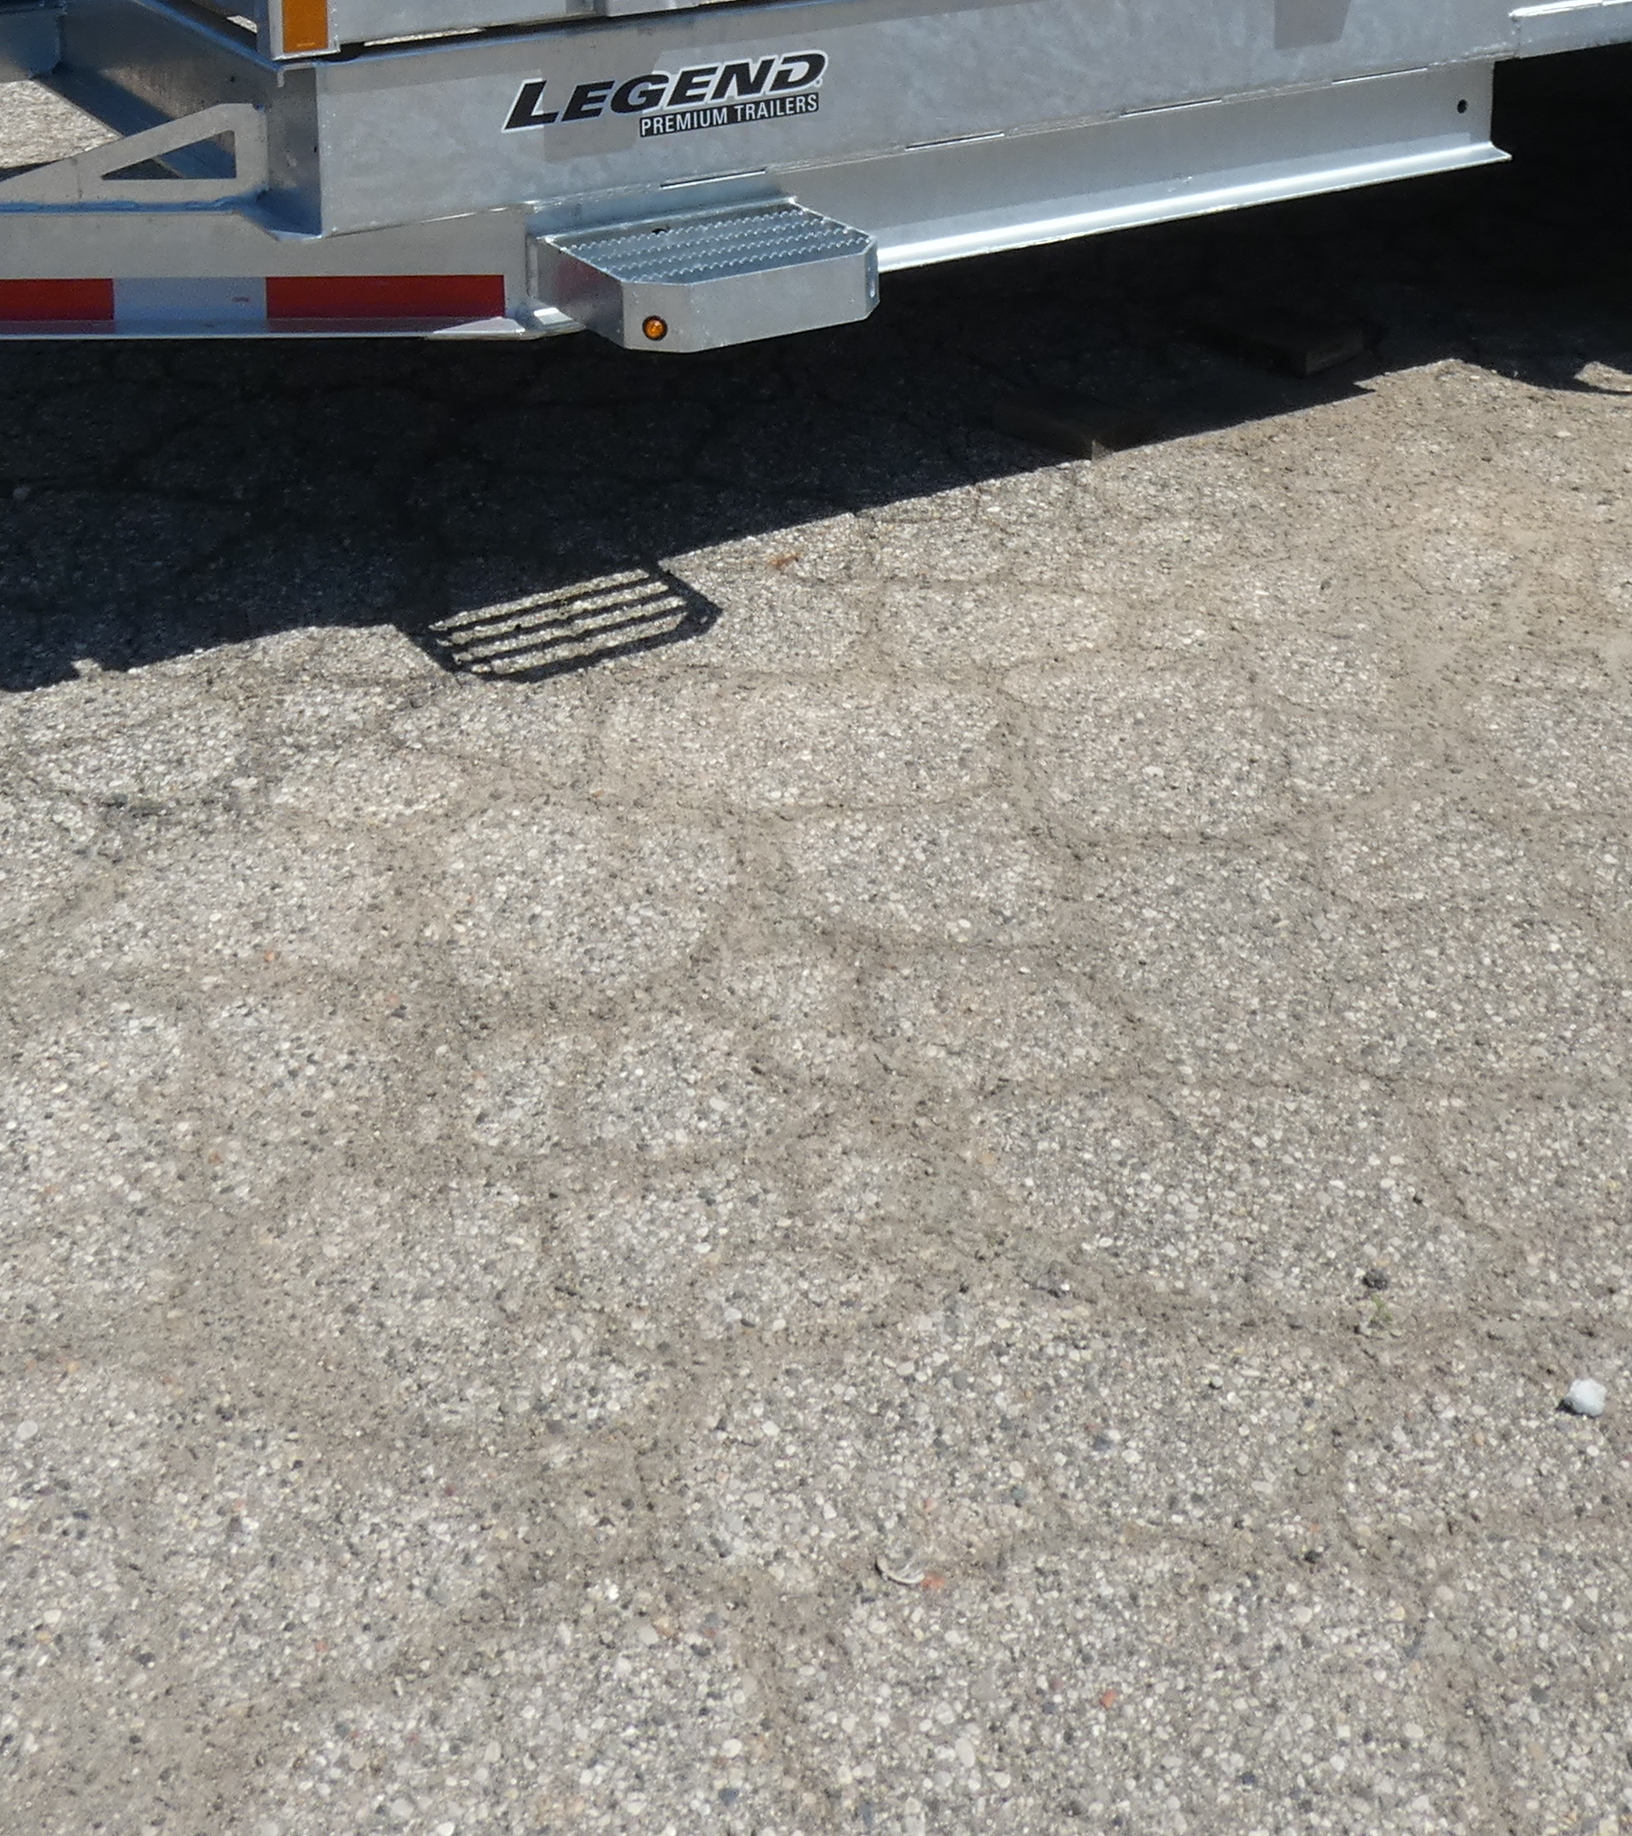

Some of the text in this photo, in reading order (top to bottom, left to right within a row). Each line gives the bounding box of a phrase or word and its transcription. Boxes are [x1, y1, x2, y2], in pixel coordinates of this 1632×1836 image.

[501, 51, 828, 133] LEGEND
[641, 93, 820, 136] PREMIUM TRAILERS
